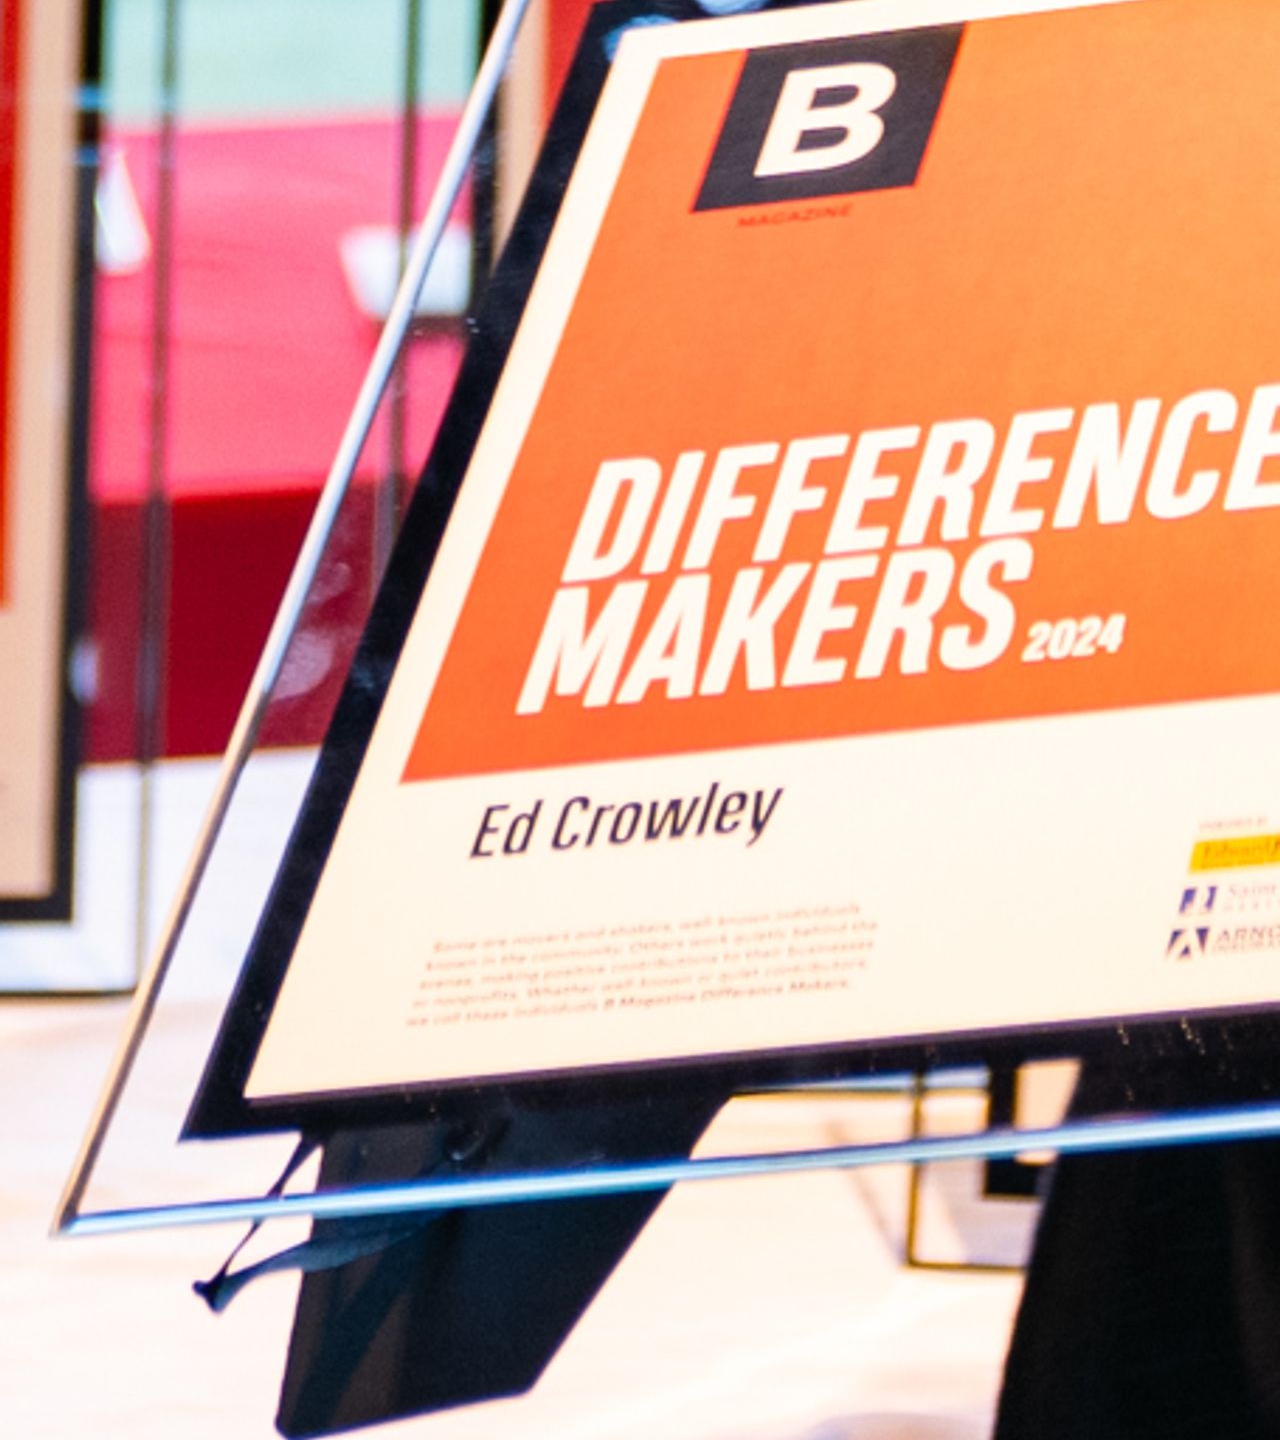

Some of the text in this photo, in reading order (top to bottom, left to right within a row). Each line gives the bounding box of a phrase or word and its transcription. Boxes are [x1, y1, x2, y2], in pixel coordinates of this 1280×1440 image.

[753, 62, 896, 178] B
[736, 203, 852, 228] MAGAZINE
[514, 537, 1127, 716] MAKERS 2024
[468, 781, 785, 859] Ed Crowley
